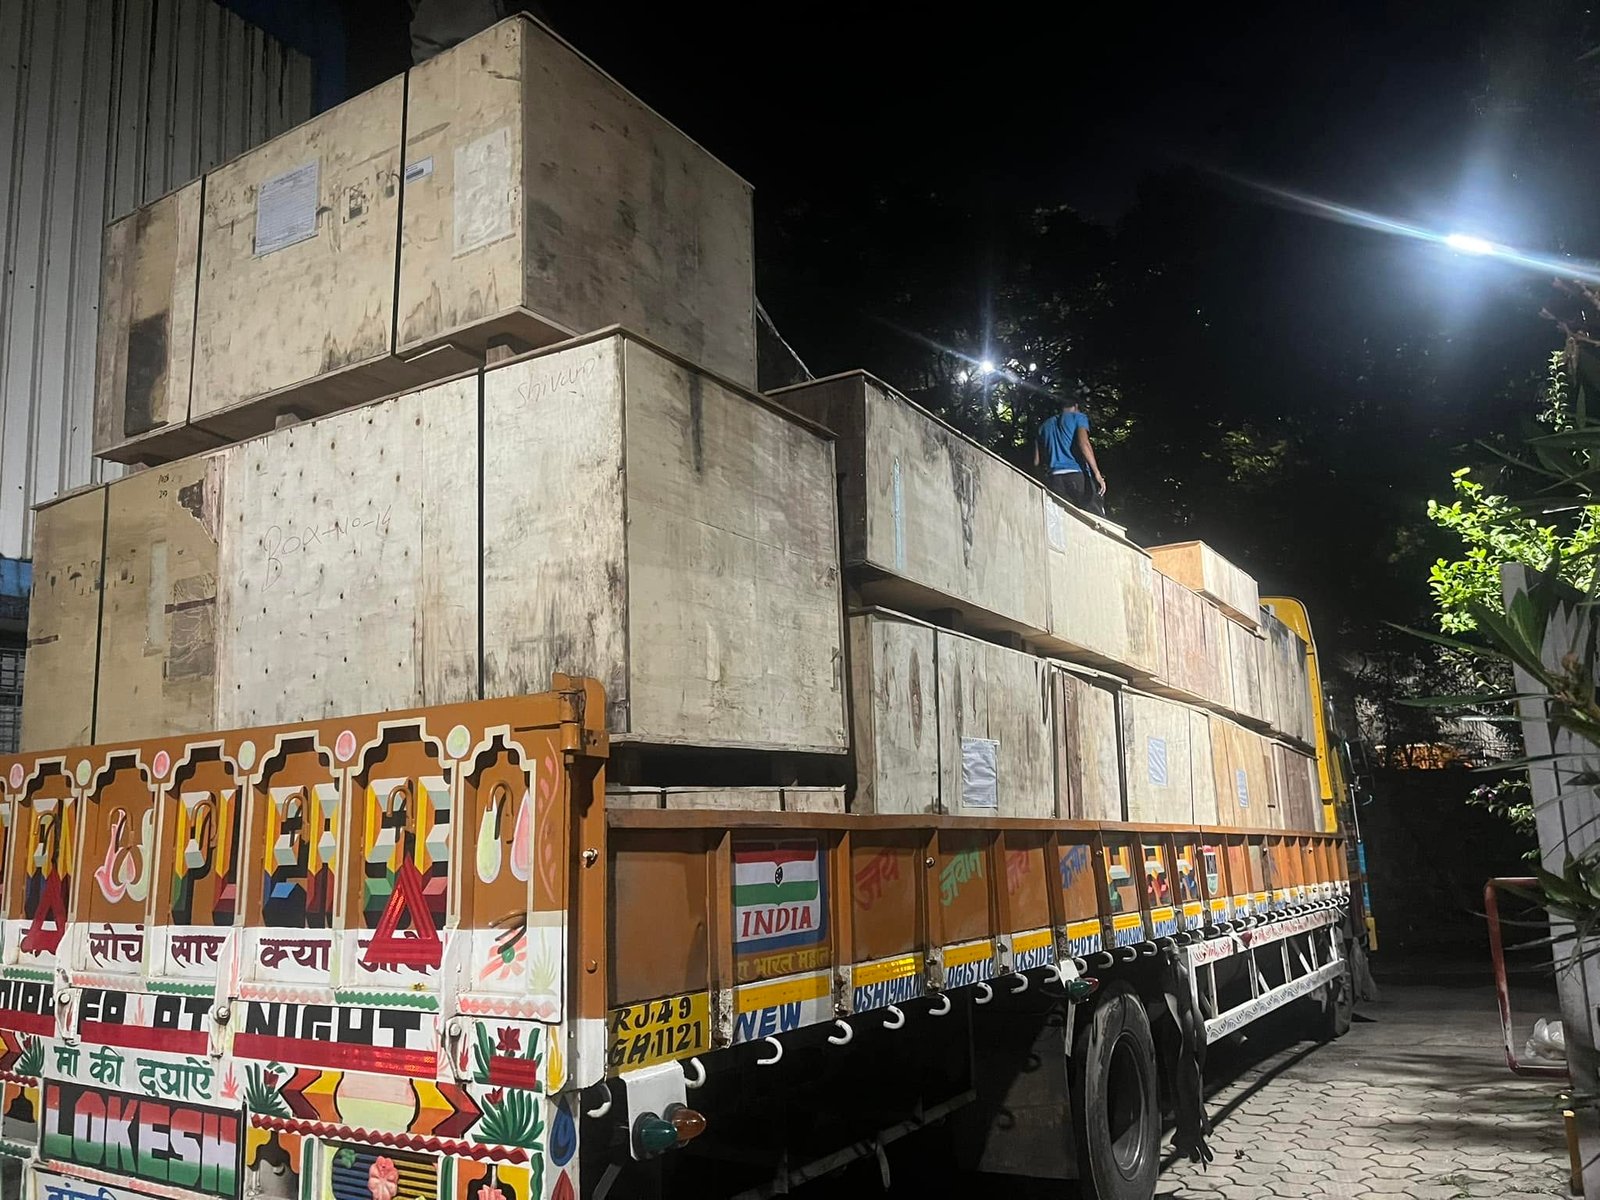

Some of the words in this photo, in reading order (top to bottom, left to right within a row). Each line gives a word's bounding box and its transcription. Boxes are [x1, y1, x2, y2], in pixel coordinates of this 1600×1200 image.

[741, 906, 813, 938] INDIA
[259, 938, 332, 972] क्या
[733, 1001, 802, 1043] NEW
[944, 958, 996, 988] OGISTIC
[1013, 945, 1054, 972] CKSIDE
[1068, 934, 1100, 957] OYOTA
[245, 1000, 423, 1049] NIGHT
[89, 1045, 126, 1088] की
[45, 1085, 237, 1200] LOKESH
